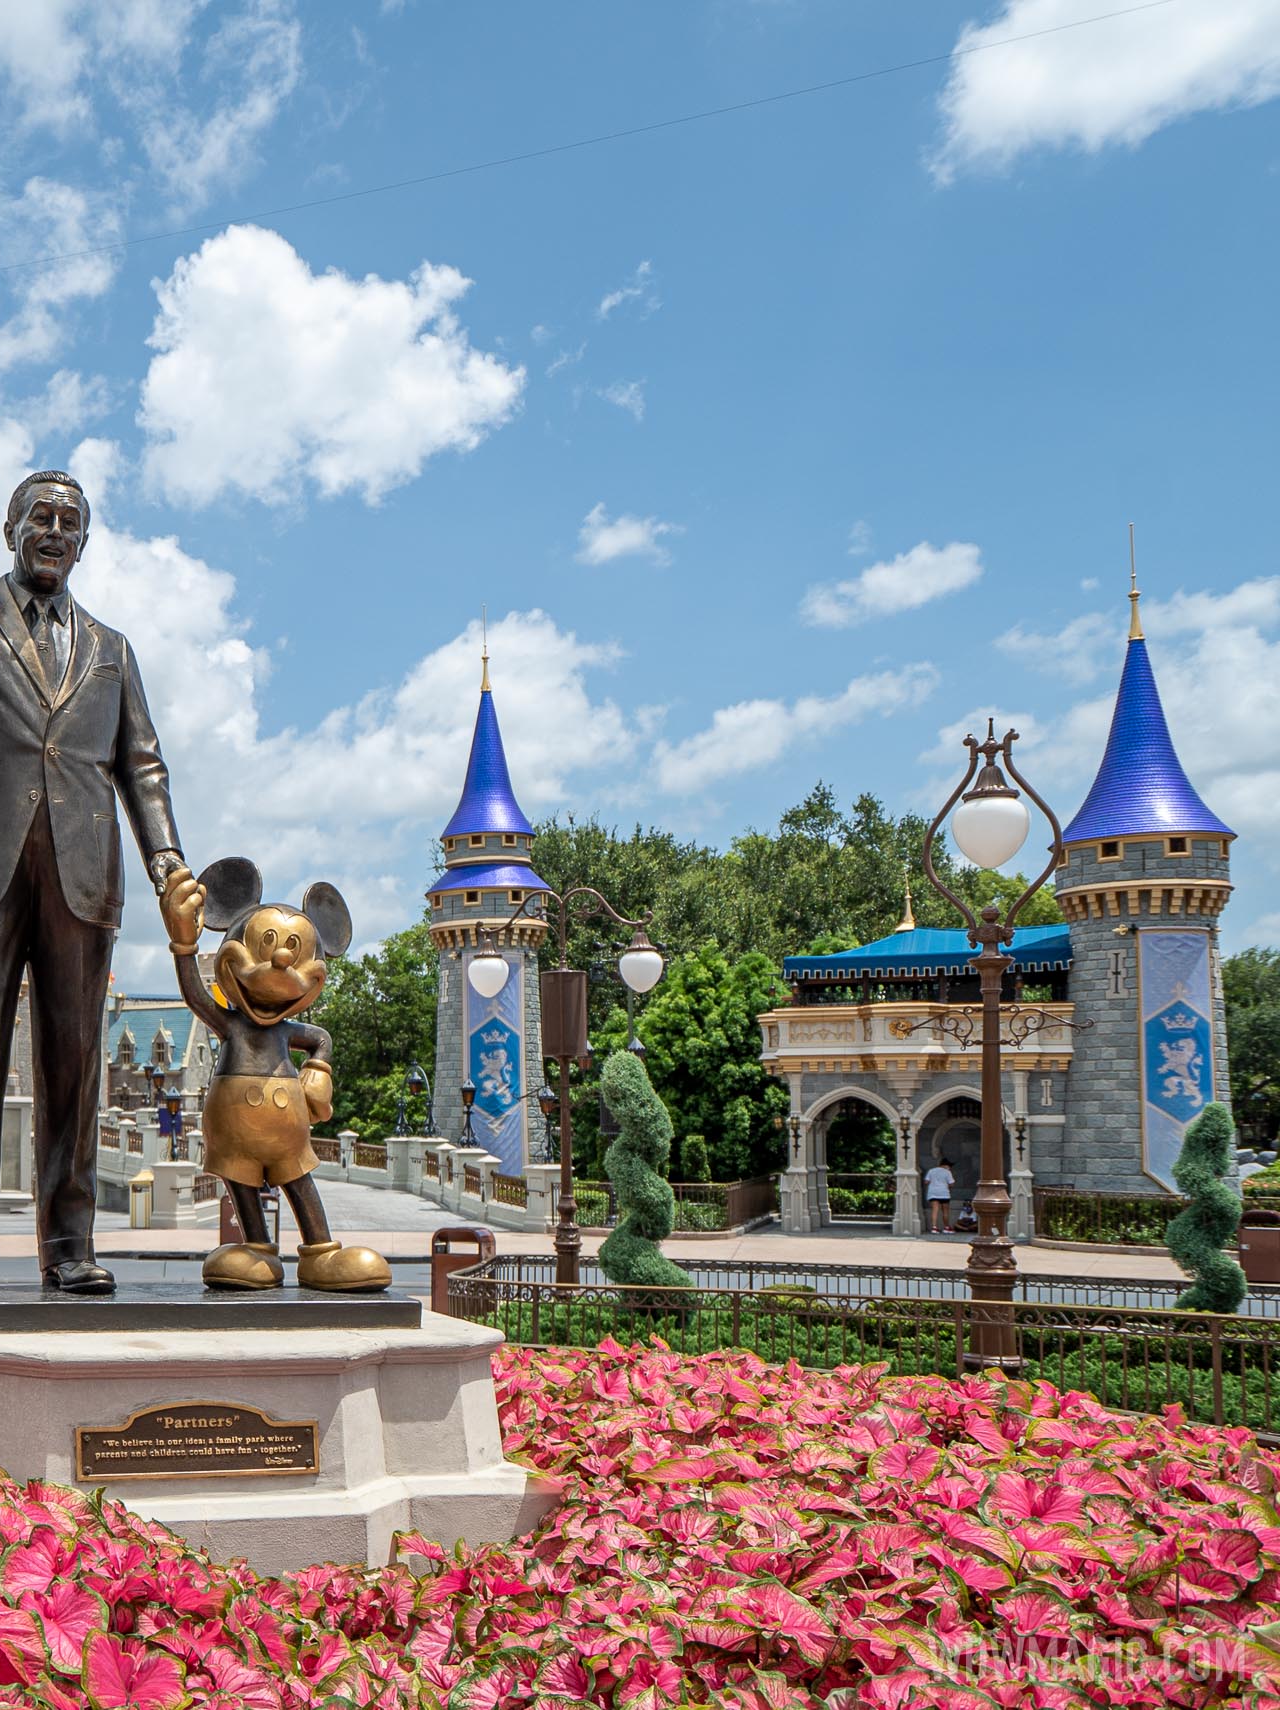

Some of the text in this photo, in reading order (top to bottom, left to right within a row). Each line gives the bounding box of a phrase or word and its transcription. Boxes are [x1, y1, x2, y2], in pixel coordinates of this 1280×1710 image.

[156, 1415, 240, 1429] "Partners"
[122, 1438, 153, 1446] believe
[156, 1438, 165, 1446] in
[167, 1438, 183, 1446] our
[216, 1436, 243, 1445] family
[246, 1435, 265, 1444] park
[94, 1450, 128, 1460] parents
[149, 1448, 186, 1457] children
[189, 1447, 213, 1456] could
[215, 1447, 236, 1455] have
[238, 1446, 253, 1454] fun
